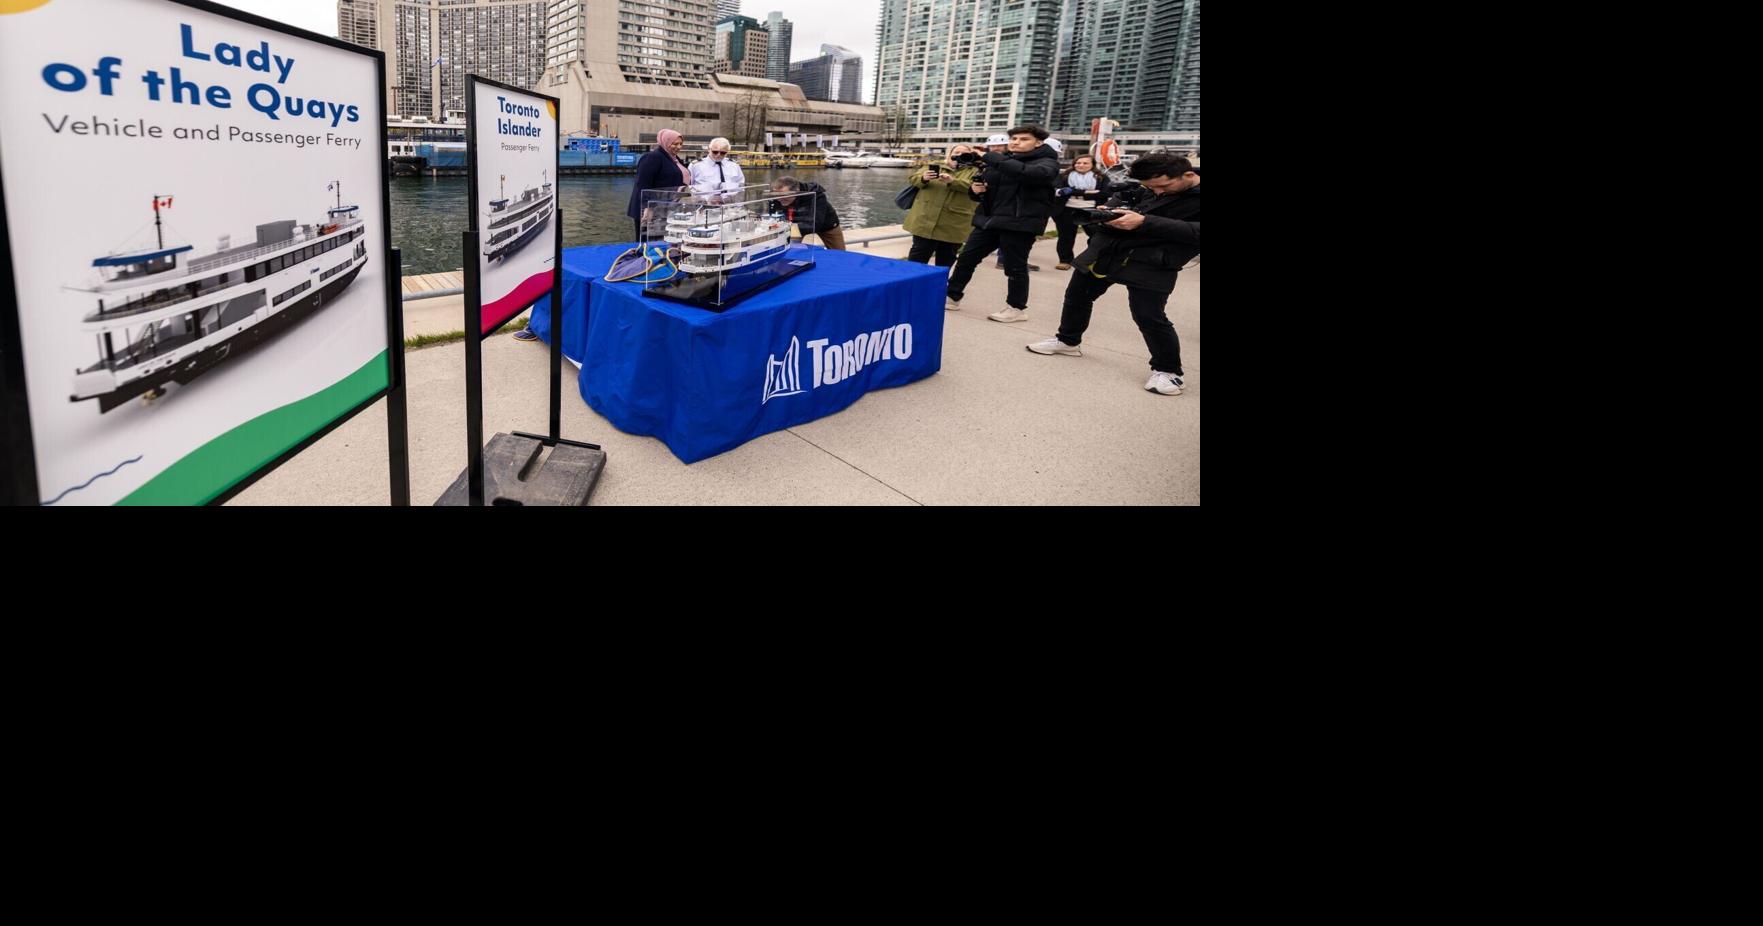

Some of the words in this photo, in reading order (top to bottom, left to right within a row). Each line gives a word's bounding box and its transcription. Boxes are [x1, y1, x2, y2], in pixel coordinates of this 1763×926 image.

[180, 23, 295, 83] Lady
[42, 57, 122, 96] of
[142, 67, 231, 109] the
[247, 83, 359, 127] Quays
[497, 96, 540, 119] Toronto
[42, 113, 163, 138] Vehicle
[173, 124, 220, 142] and
[229, 126, 320, 148] Passenger
[326, 133, 361, 150] Ferry
[498, 118, 541, 138] Islander
[501, 142, 527, 153] Passenger
[528, 143, 540, 152] Ferry
[806, 323, 913, 389] TORONTO
